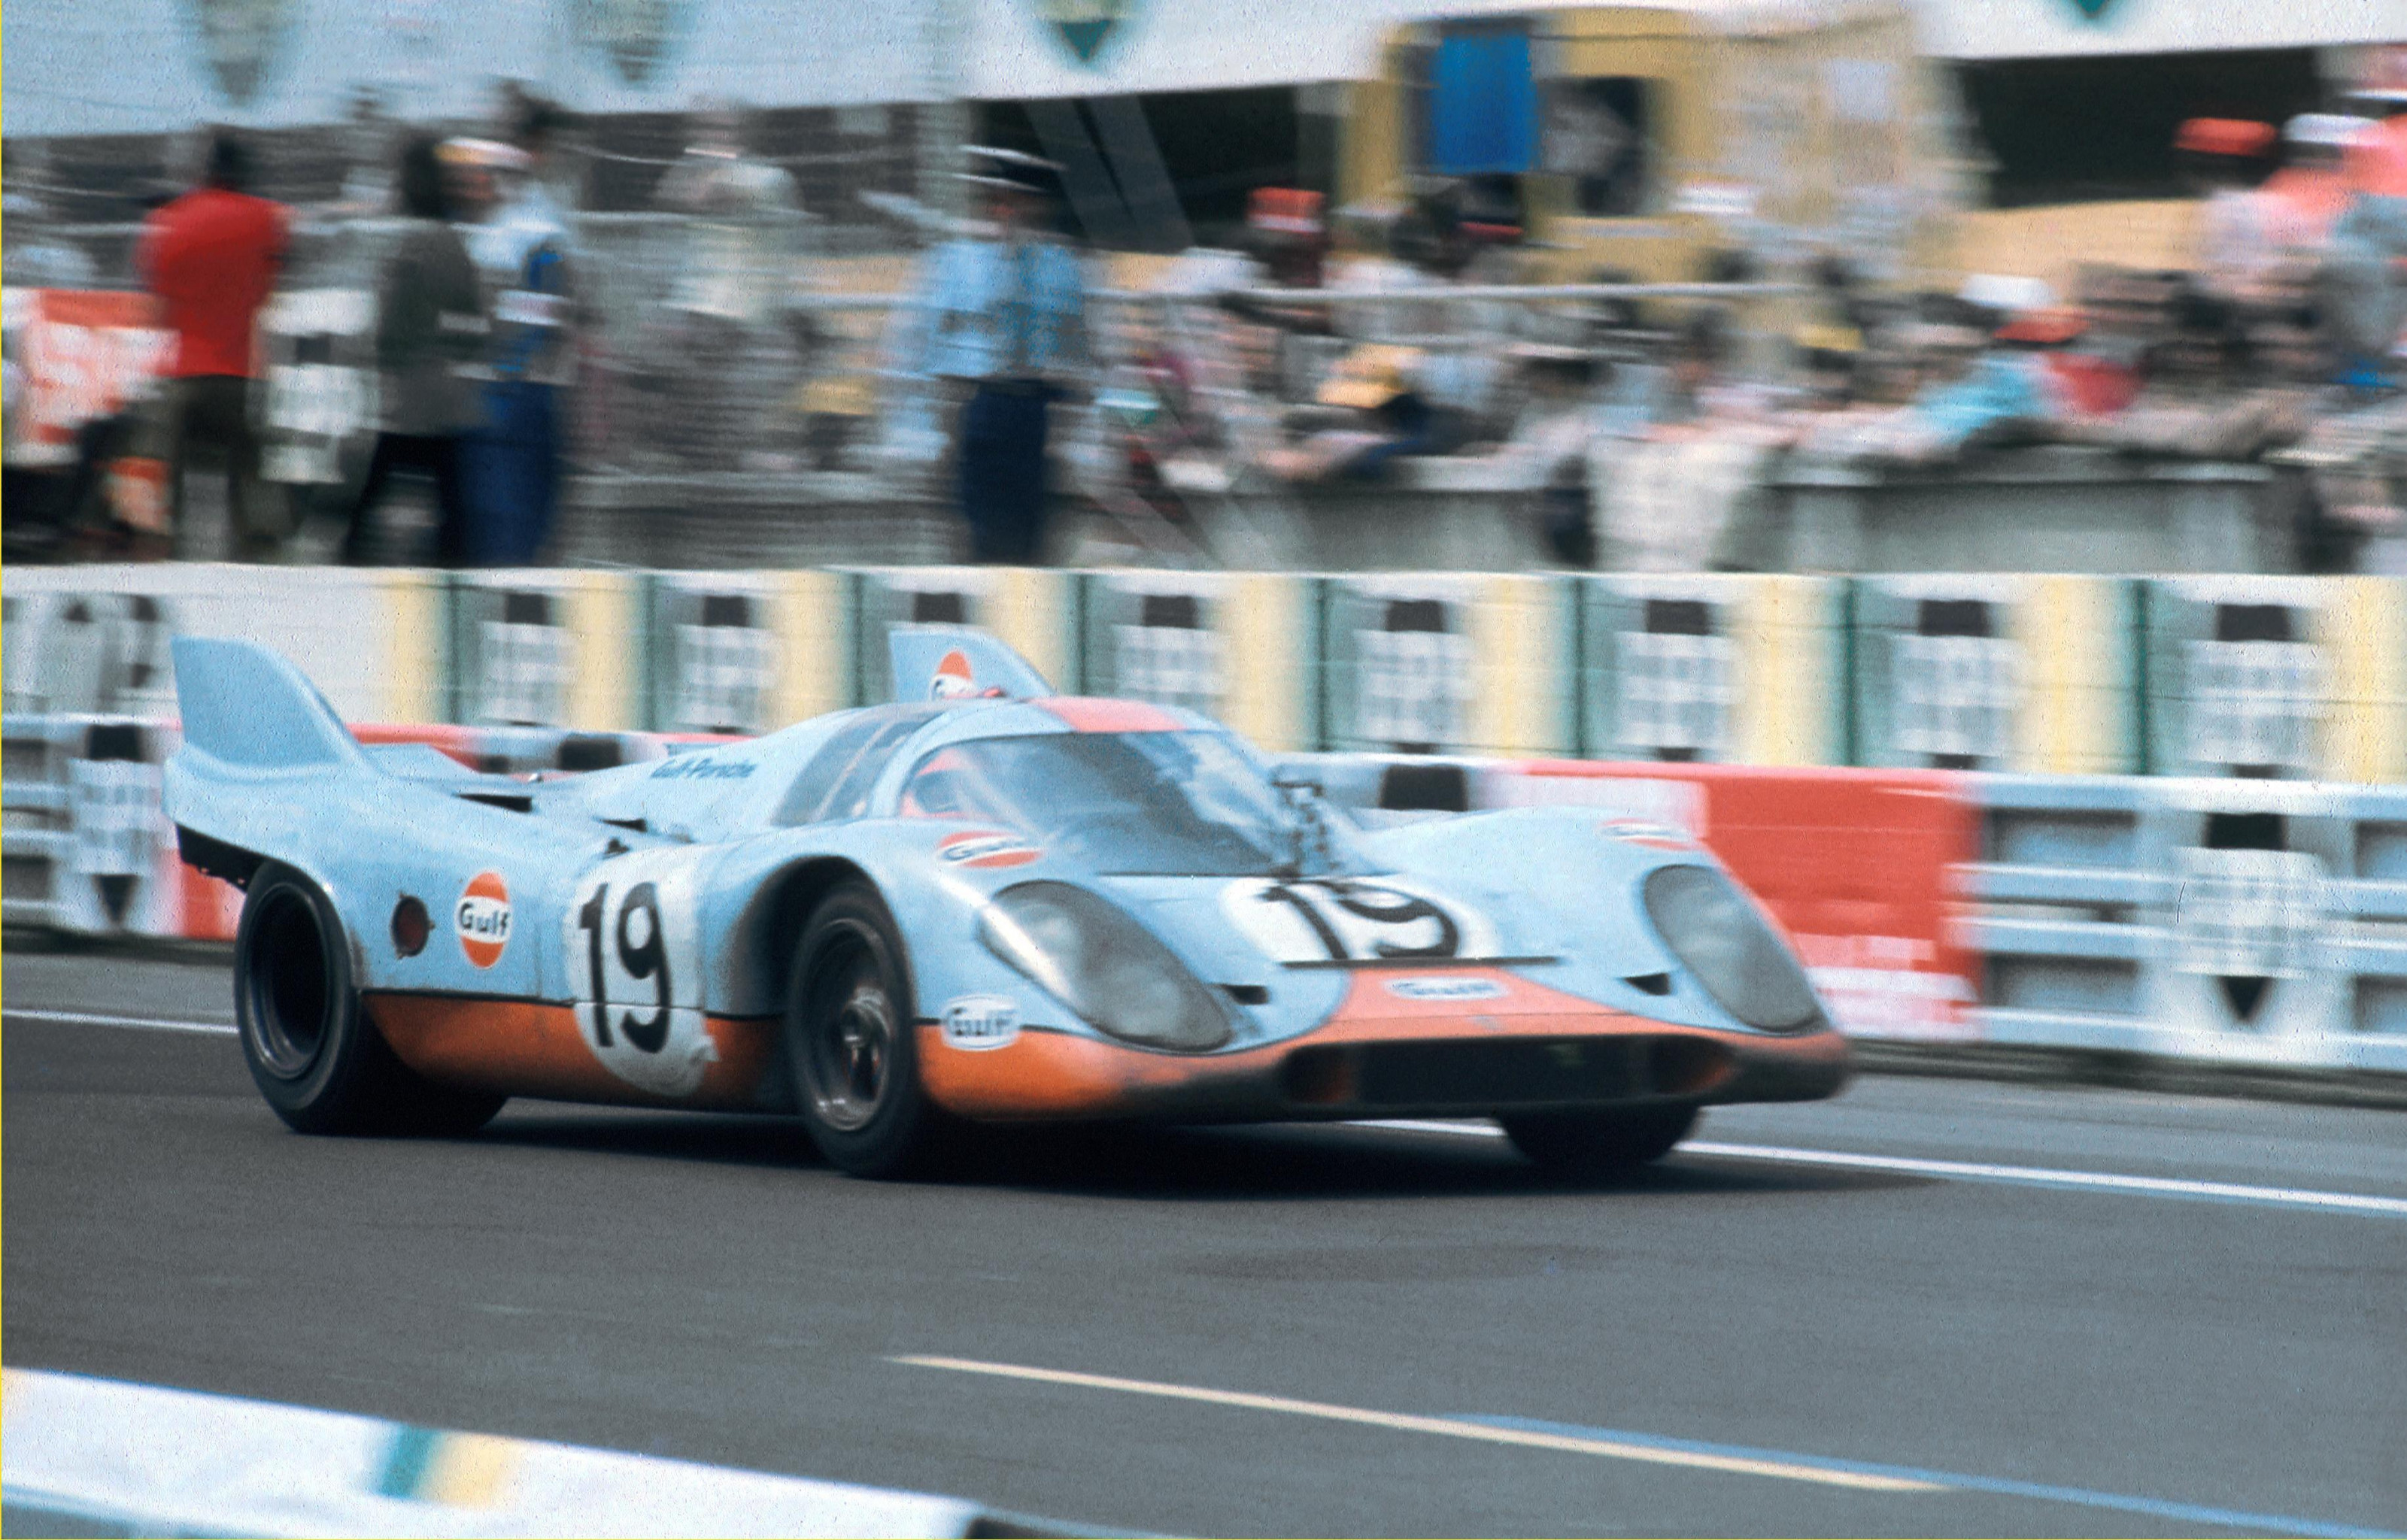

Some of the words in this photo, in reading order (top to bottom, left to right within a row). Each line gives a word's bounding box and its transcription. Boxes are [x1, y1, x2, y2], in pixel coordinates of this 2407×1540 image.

[458, 902, 509, 936] Gulf
[1257, 878, 1458, 959] 19
[579, 881, 672, 1053] 19
[947, 1007, 1018, 1037] Gulf
